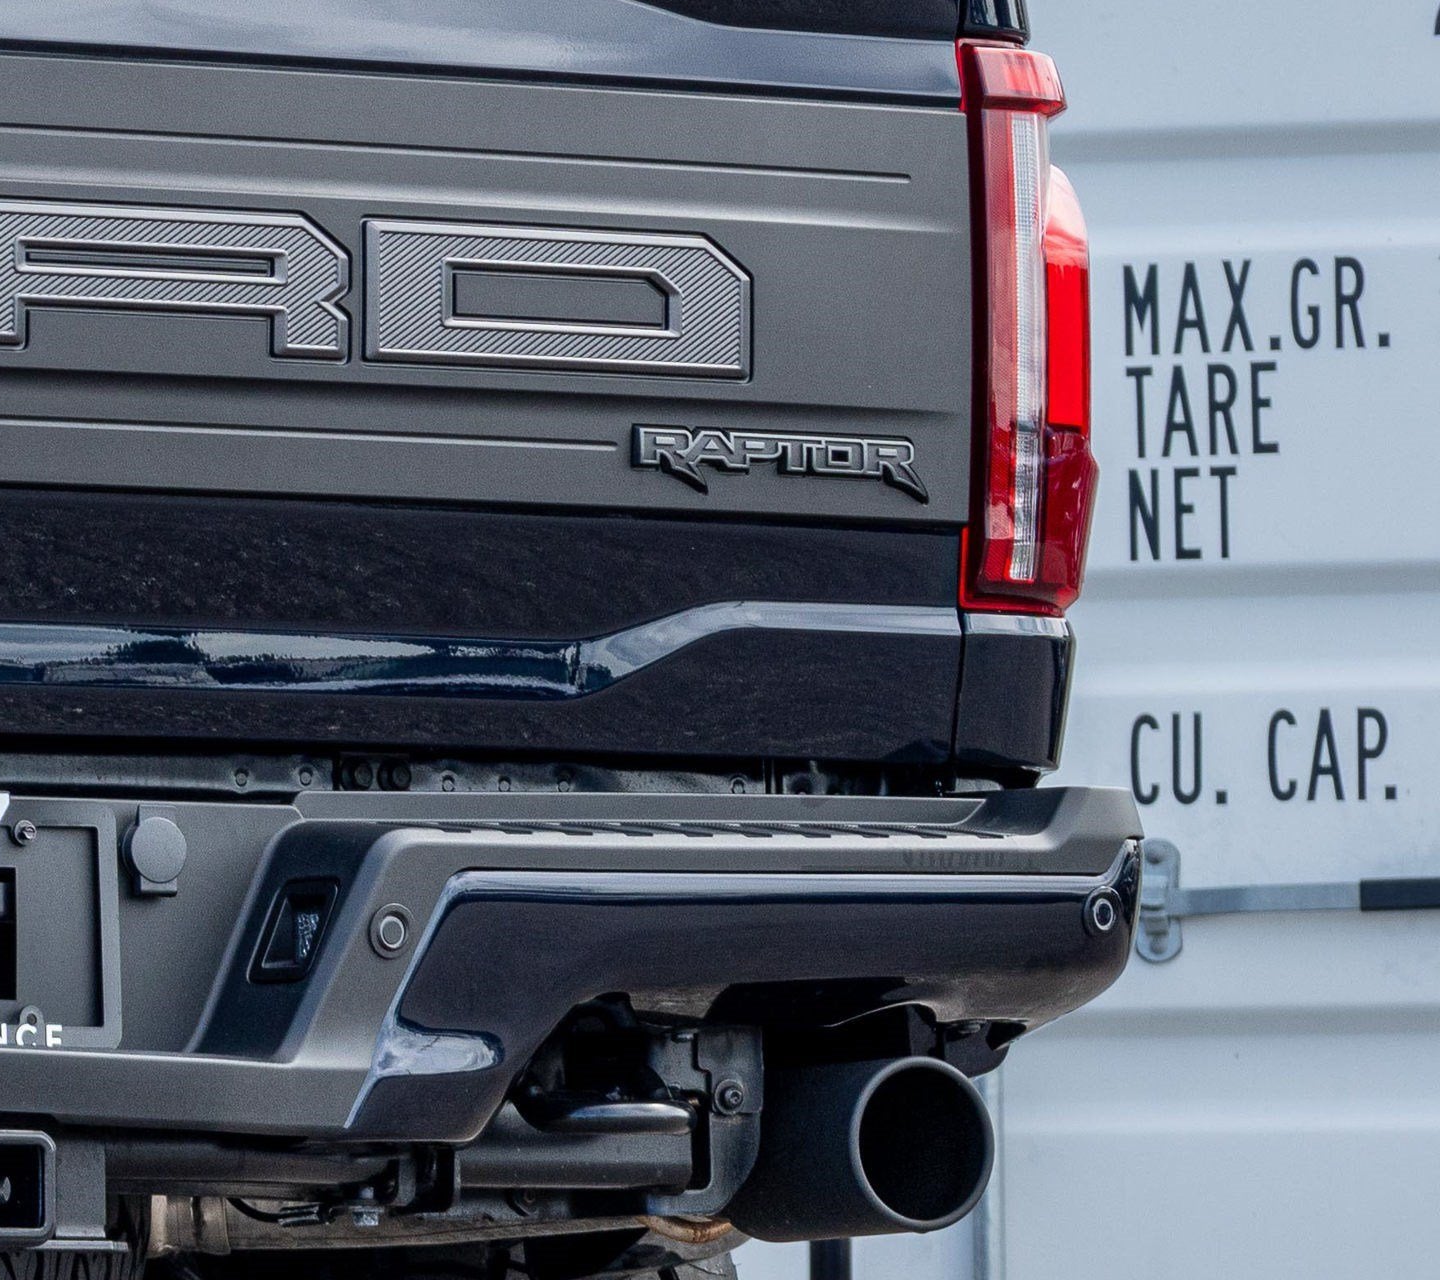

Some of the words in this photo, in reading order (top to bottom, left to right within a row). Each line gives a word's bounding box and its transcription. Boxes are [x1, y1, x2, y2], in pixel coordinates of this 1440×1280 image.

[1126, 361, 1281, 459] TARE
[631, 423, 929, 505] RAPTOR
[1129, 466, 1237, 561] NET
[1130, 711, 1229, 805] CU.
[1267, 707, 1398, 802] CAP.
